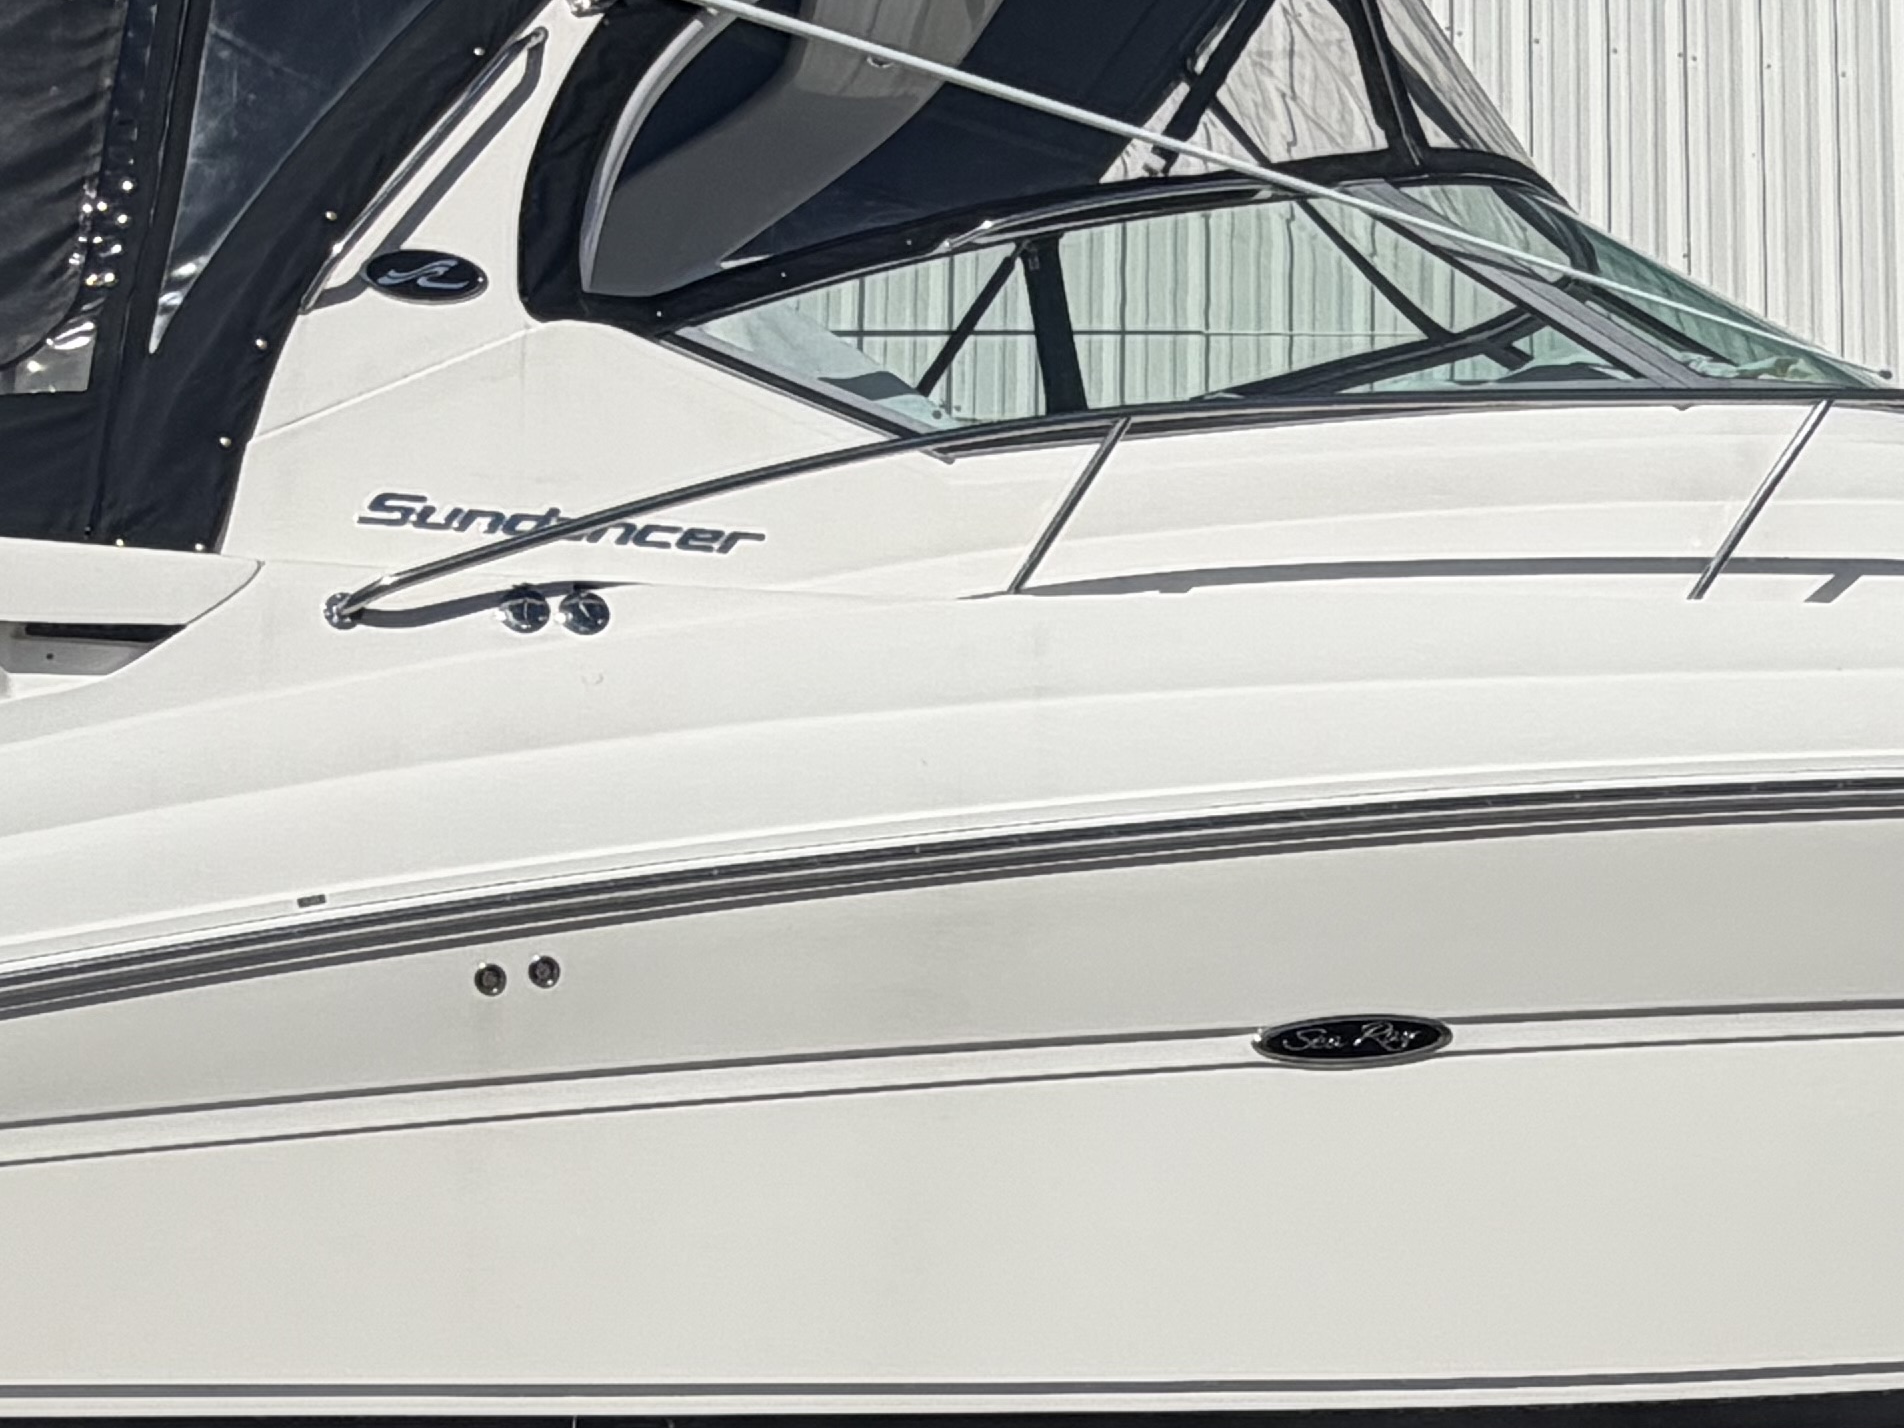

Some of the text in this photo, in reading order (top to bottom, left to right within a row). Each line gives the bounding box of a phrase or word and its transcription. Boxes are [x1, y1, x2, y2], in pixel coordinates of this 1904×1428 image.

[356, 492, 765, 553] Sundncer
[1283, 1022, 1420, 1052] Sea Ray
